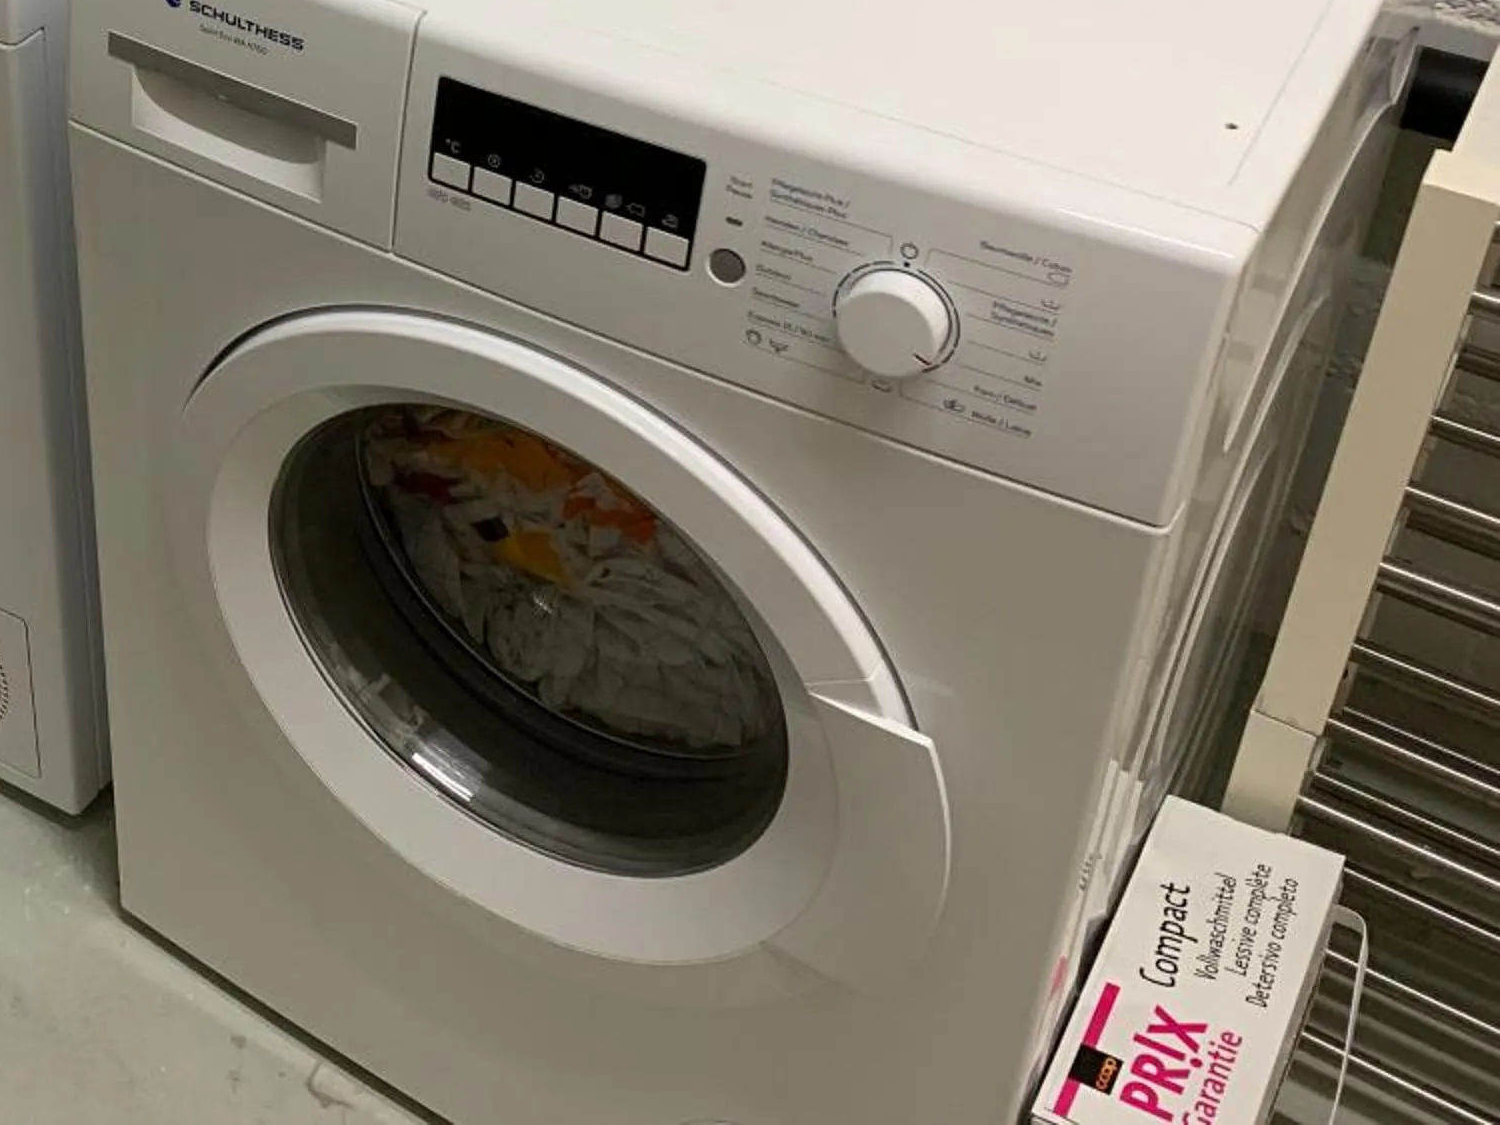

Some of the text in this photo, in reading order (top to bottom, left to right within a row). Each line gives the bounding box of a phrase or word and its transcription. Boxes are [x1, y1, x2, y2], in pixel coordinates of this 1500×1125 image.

[189, 0, 305, 51] SCHULTHESS
[1138, 881, 1199, 989] Compact
[1193, 872, 1237, 980] Vollwaschmittel
[1224, 863, 1273, 977] Lessive complète
[1245, 877, 1299, 1008] Detersivo completo
[1095, 1056, 1118, 1091] coop
